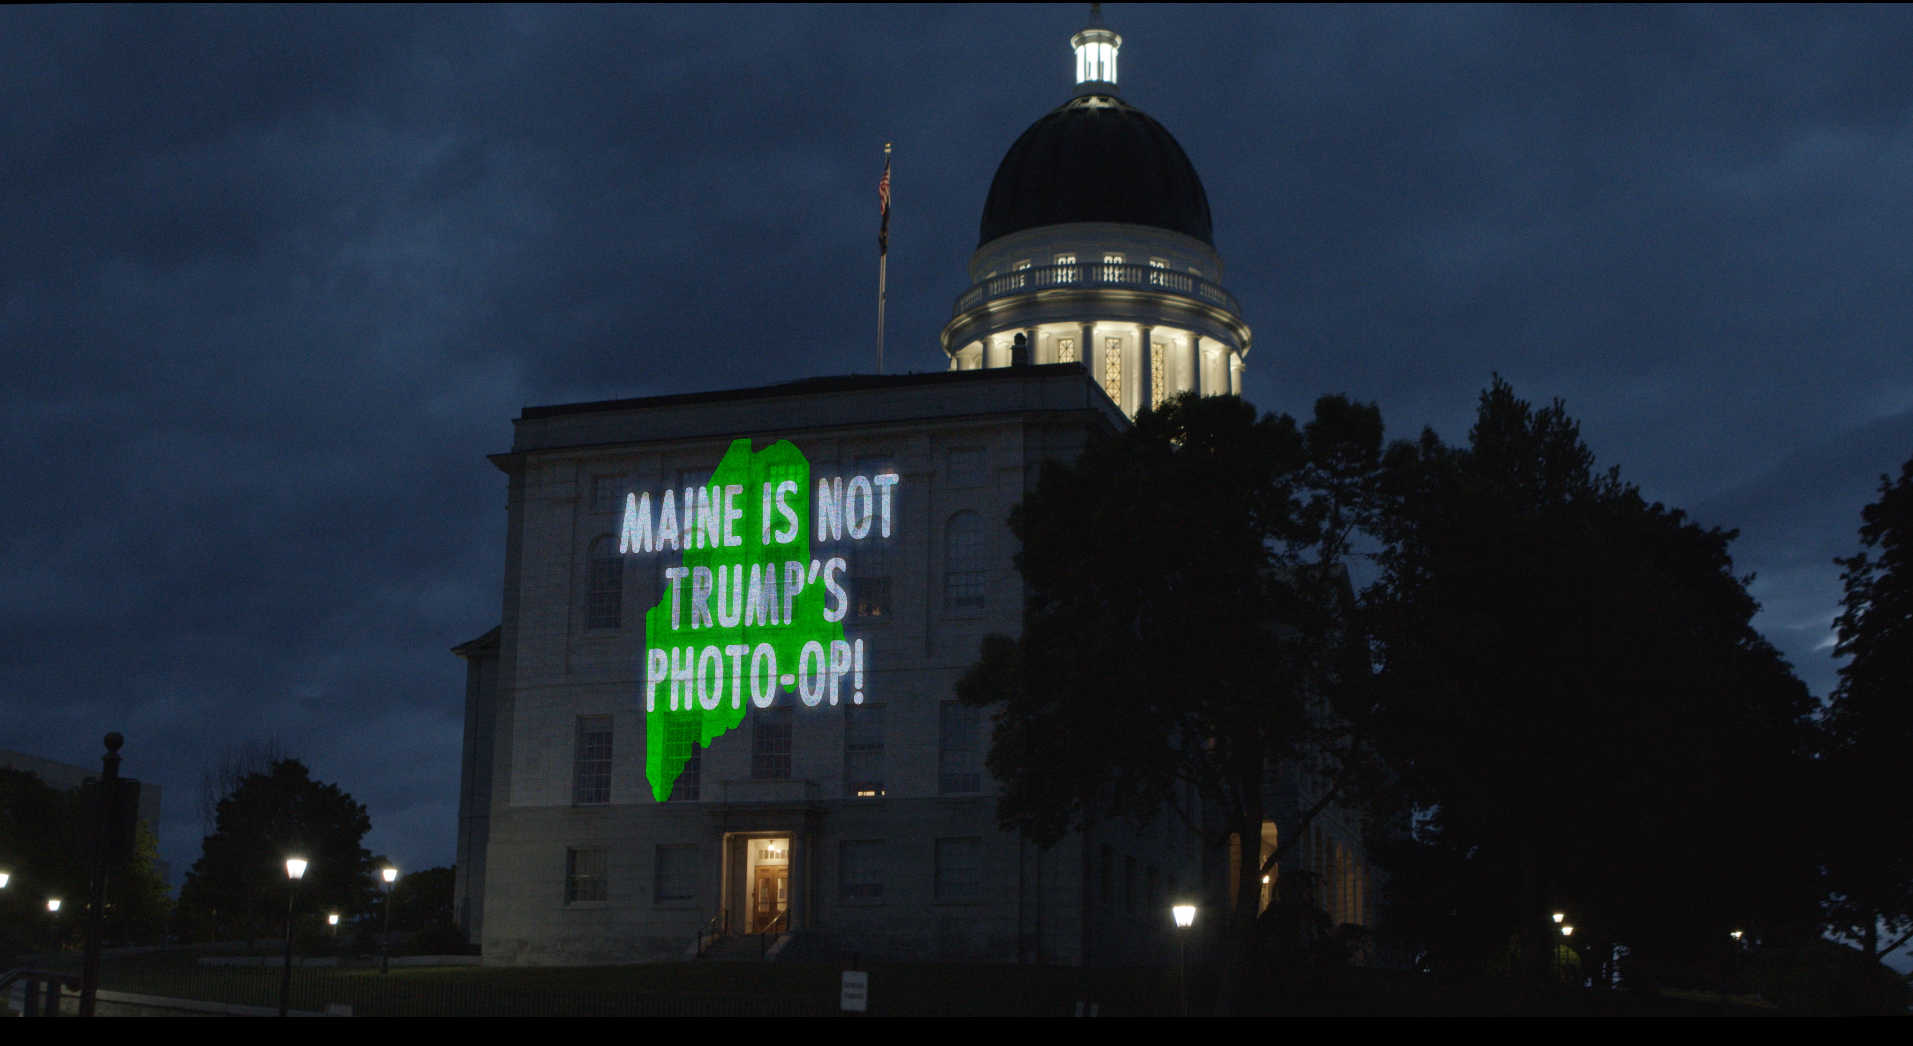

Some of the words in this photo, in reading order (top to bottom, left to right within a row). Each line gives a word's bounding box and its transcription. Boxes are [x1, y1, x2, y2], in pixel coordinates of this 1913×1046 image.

[620, 484, 744, 554] MAINE
[761, 480, 799, 545] IS
[817, 473, 900, 542] NOT
[665, 557, 848, 630] TRUMP'S
[646, 638, 864, 712] PHOTO-OP!
